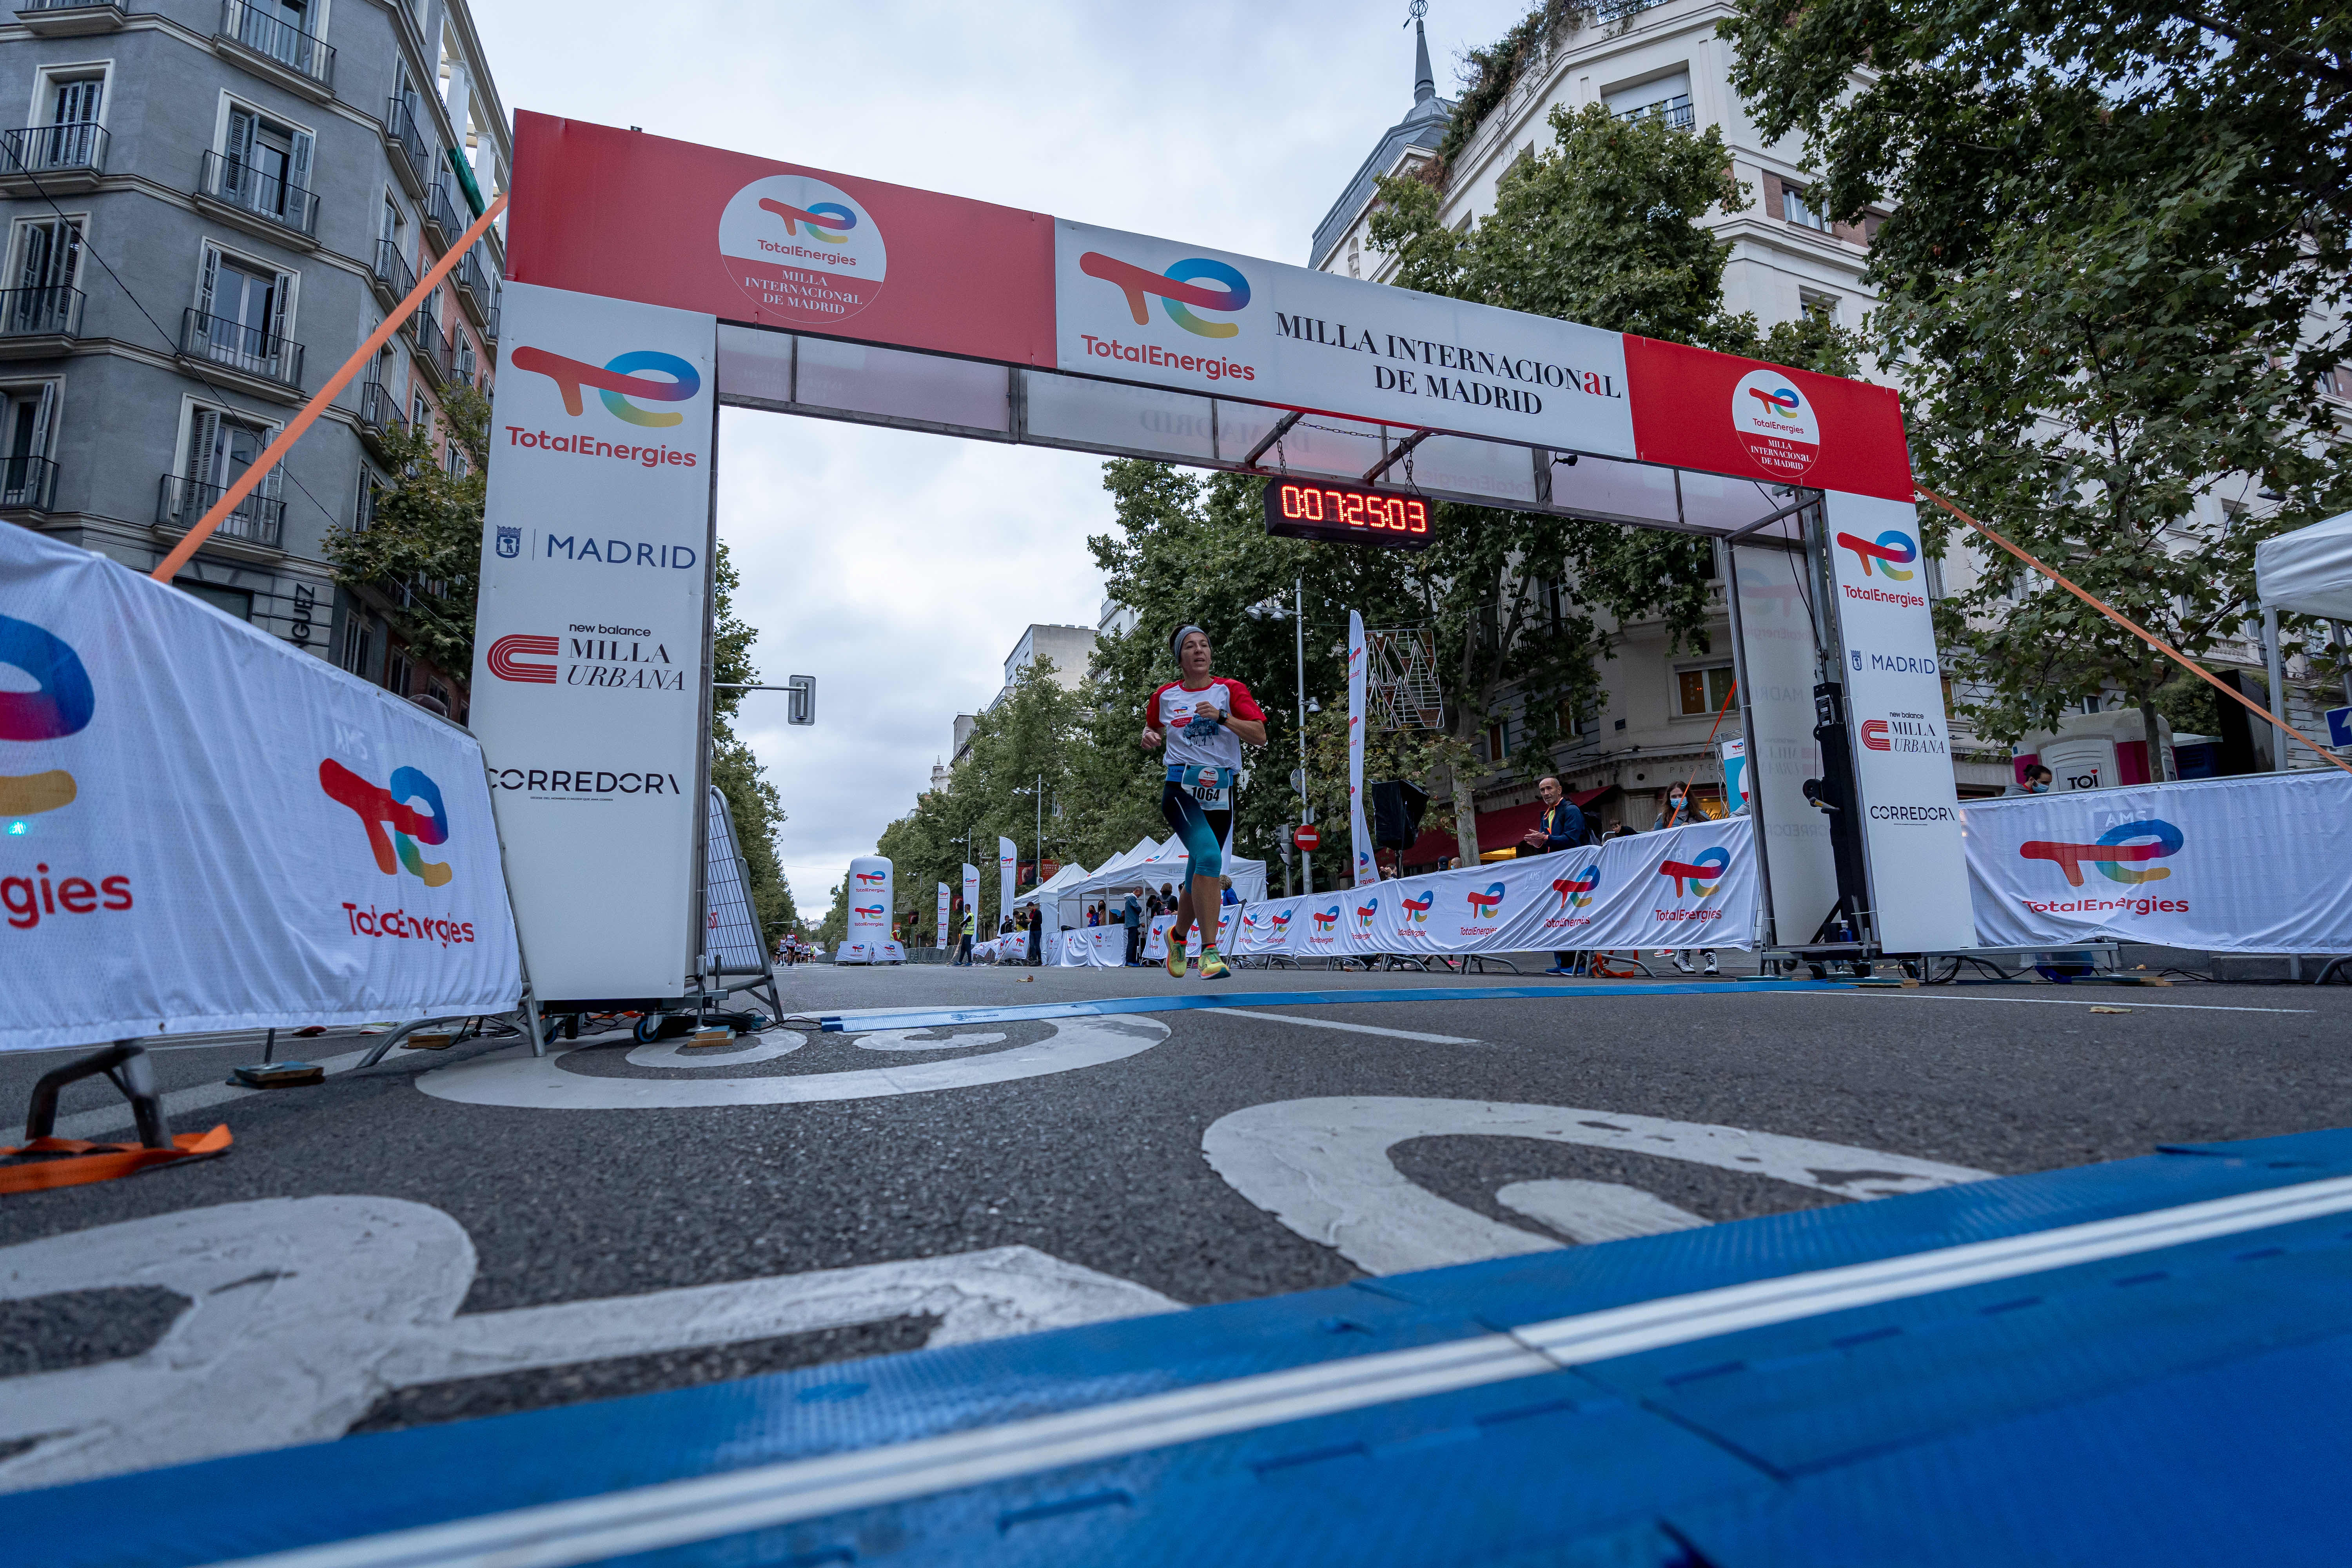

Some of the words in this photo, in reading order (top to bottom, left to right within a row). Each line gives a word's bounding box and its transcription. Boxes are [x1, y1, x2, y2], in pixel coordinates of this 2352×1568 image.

[757, 238, 857, 268] TotalEnergies
[782, 270, 828, 287] MILLA
[762, 292, 785, 306] DE
[787, 294, 845, 314] MADRID
[1275, 312, 1380, 356] MILLA
[1081, 334, 1256, 381] TotalEnergies
[1373, 365, 1415, 395] DE
[1425, 373, 1543, 415] MADRID
[1753, 417, 1804, 435] TotalEnergies
[505, 426, 697, 468] TotalEnergies
[1768, 439, 1793, 450] MILLA
[1761, 456, 1772, 466] DE
[1773, 457, 1804, 470] MADRID
[547, 534, 696, 569] MADRID
[1843, 585, 1924, 608] TotalEnergies
[569, 624, 595, 634] new
[598, 624, 652, 637] balance
[568, 638, 673, 664] MILLA
[1871, 653, 1935, 674] MADRID
[567, 665, 686, 691] URBANA
[1891, 721, 1936, 737] MILLA
[1894, 738, 1945, 754] URBANA
[1192, 787, 1220, 802] 1064
[2022, 896, 2189, 916] TotalEnergies
